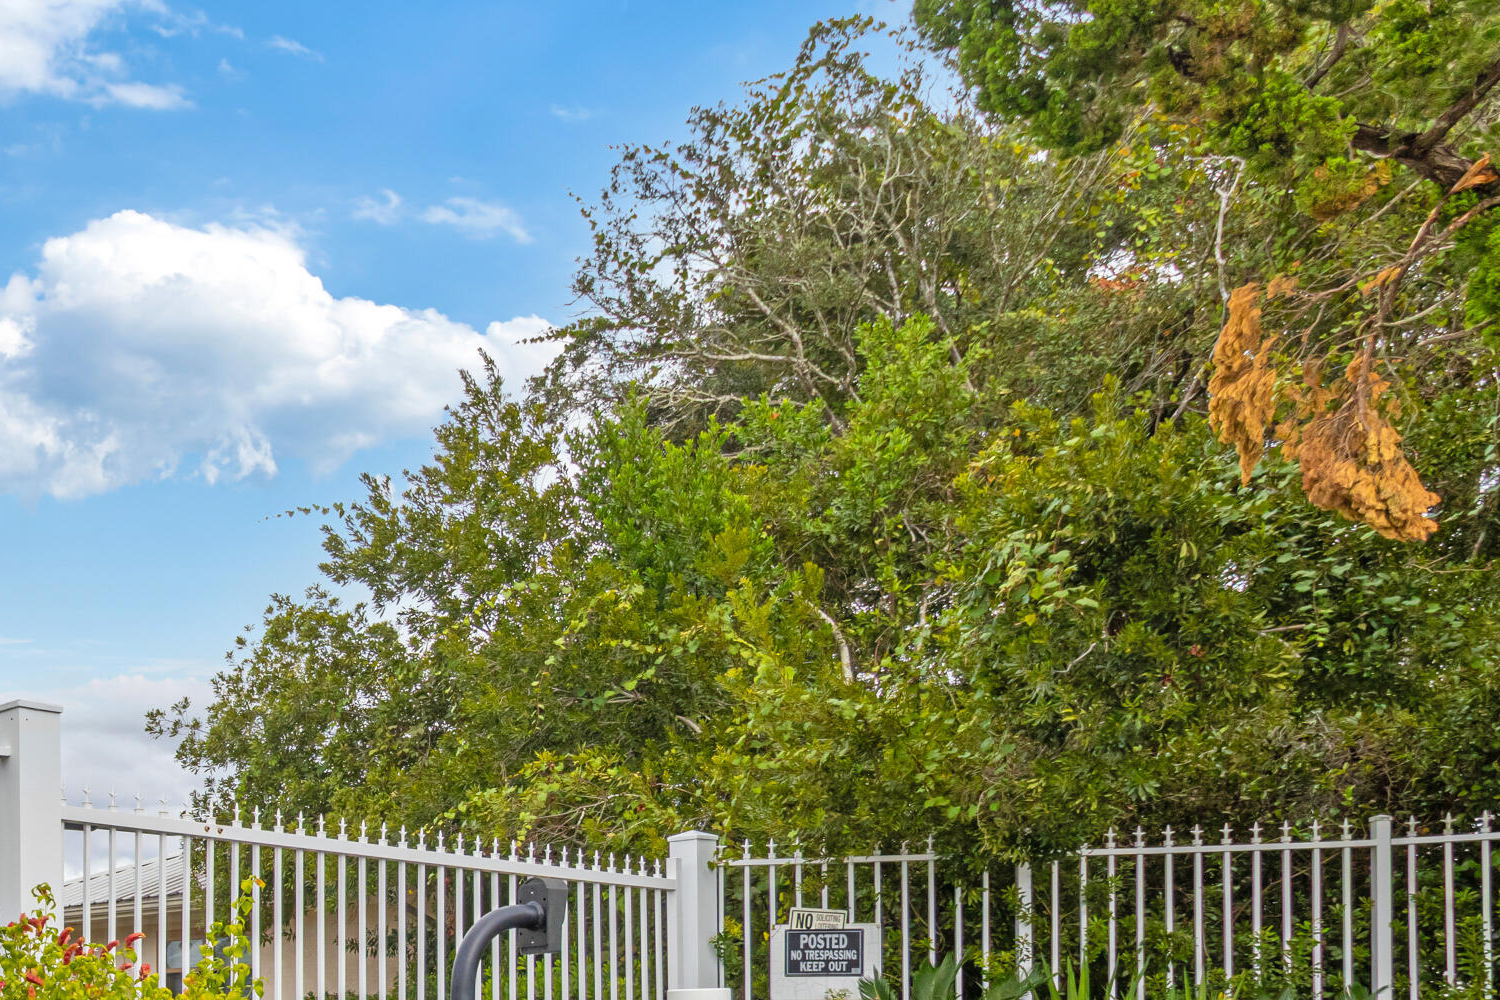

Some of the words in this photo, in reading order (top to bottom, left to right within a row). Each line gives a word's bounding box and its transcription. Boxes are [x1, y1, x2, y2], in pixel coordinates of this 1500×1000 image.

[796, 913, 813, 929] NO
[799, 934, 848, 949] POSTED
[790, 950, 802, 961] NO
[805, 950, 857, 961] TRESPASSING
[799, 961, 825, 972] KEEP
[828, 961, 848, 972] OUT
